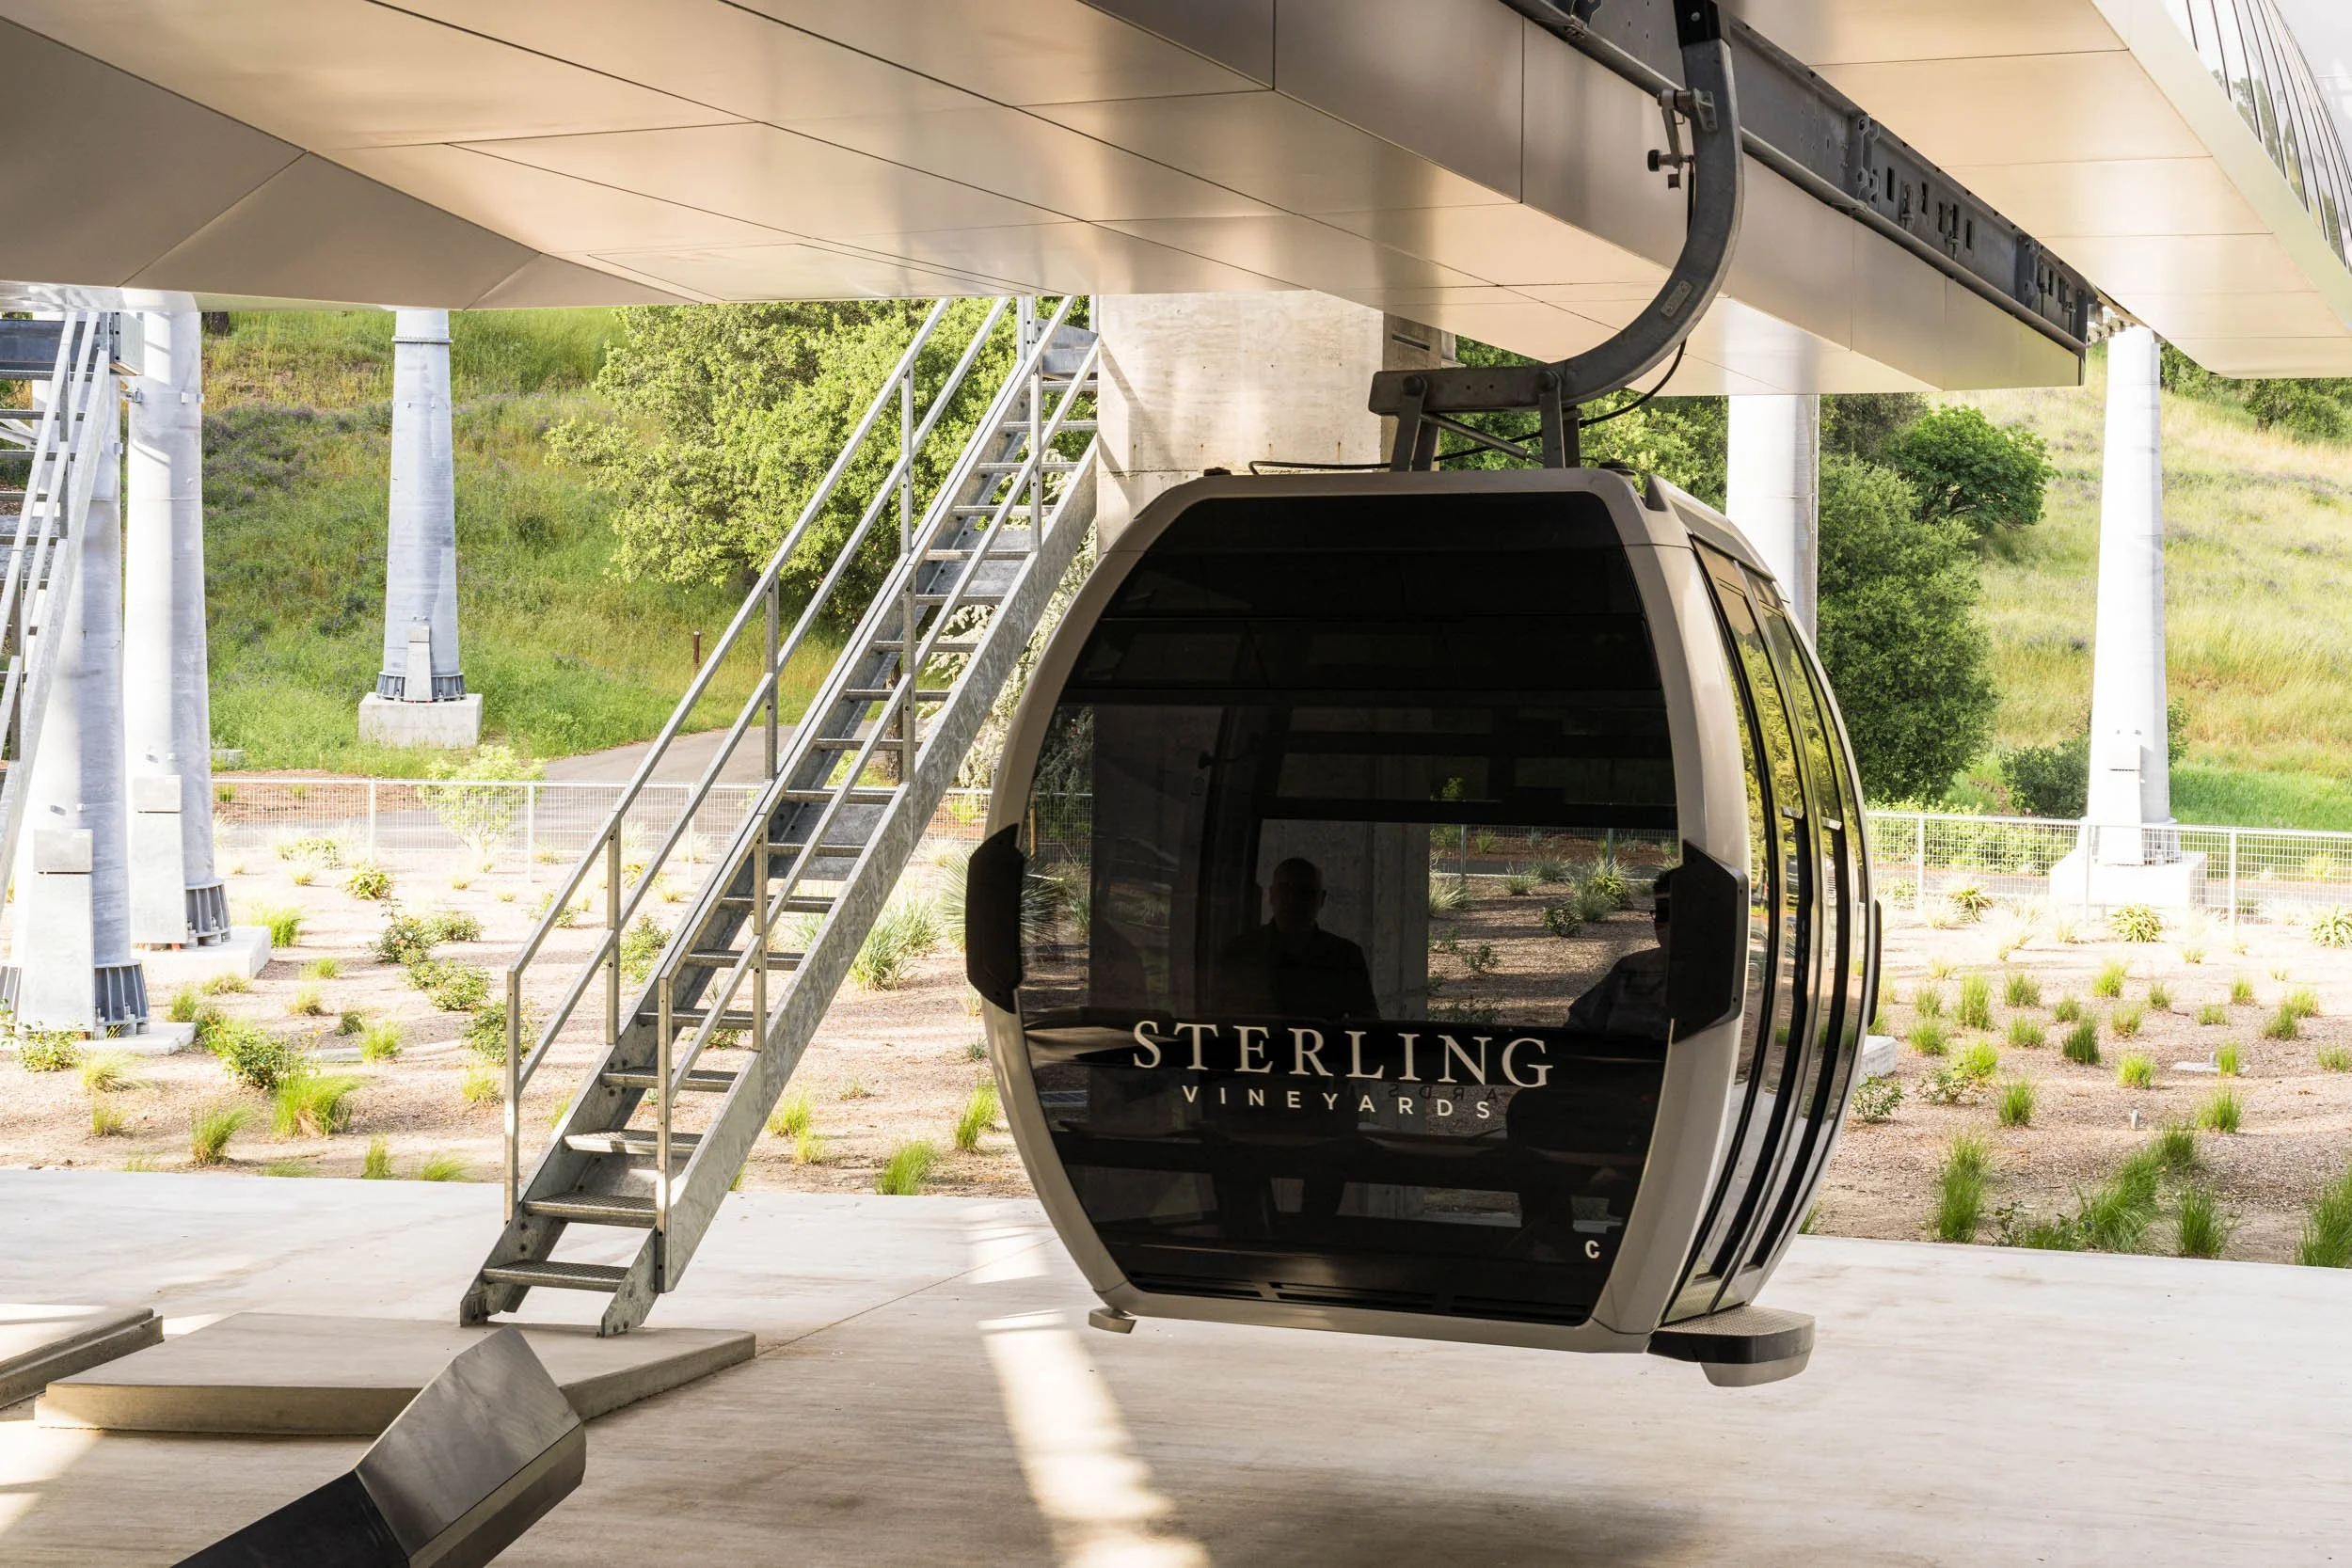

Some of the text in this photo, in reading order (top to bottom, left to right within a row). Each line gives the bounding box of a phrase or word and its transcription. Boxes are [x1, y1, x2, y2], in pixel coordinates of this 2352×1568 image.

[1133, 1021, 1553, 1088] STERLING
[1182, 1085, 1491, 1119] VINEYARDS
[1584, 1239, 1601, 1259] C
